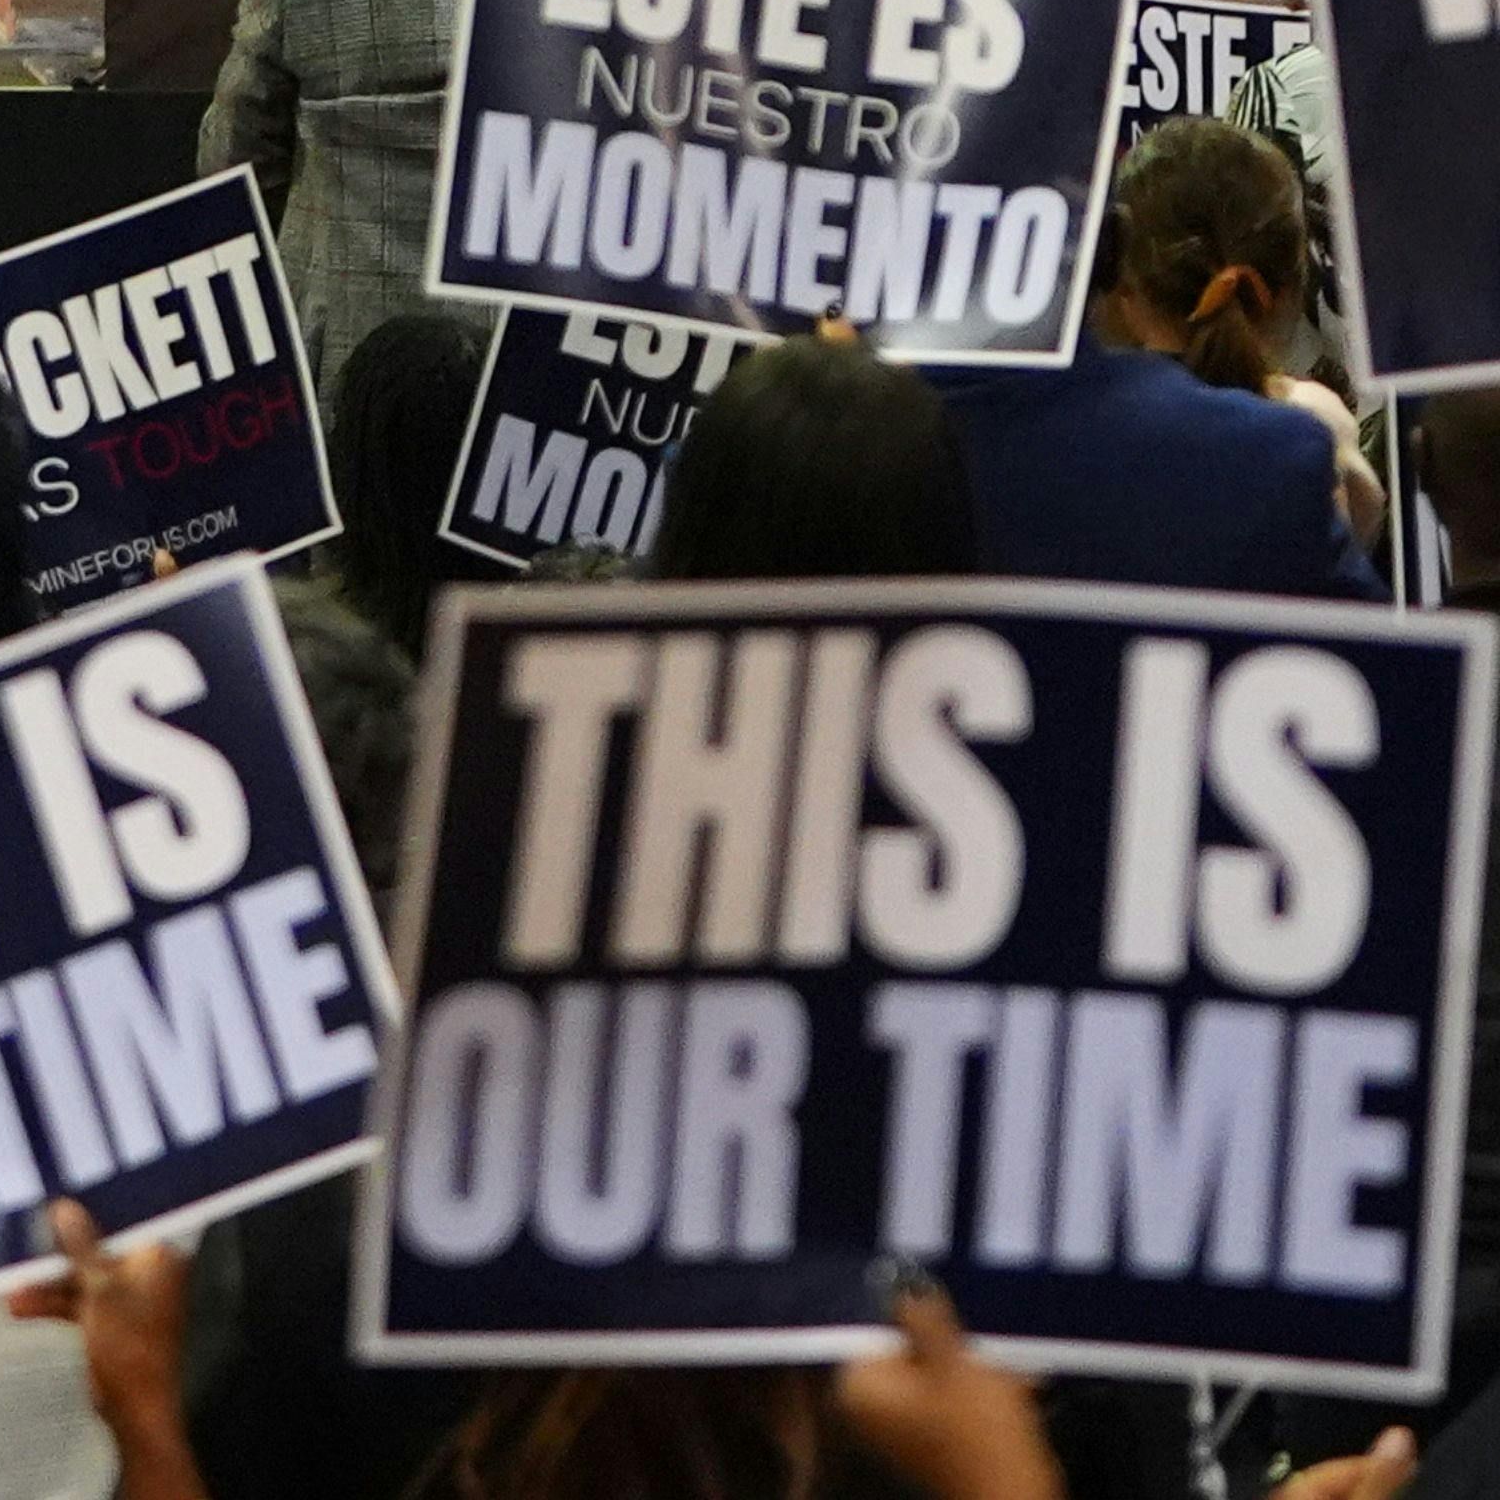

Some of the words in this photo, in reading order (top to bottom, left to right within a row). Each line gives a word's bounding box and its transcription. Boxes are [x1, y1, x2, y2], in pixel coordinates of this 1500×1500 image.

[577, 45, 960, 171] NUESTRO
[463, 109, 1070, 328] MOMENTO
[85, 376, 301, 489] TOUGH
[504, 623, 1035, 971] THIS
[1102, 638, 1383, 996] IS
[396, 977, 811, 1269] OUR
[864, 979, 1419, 1298] TIME
